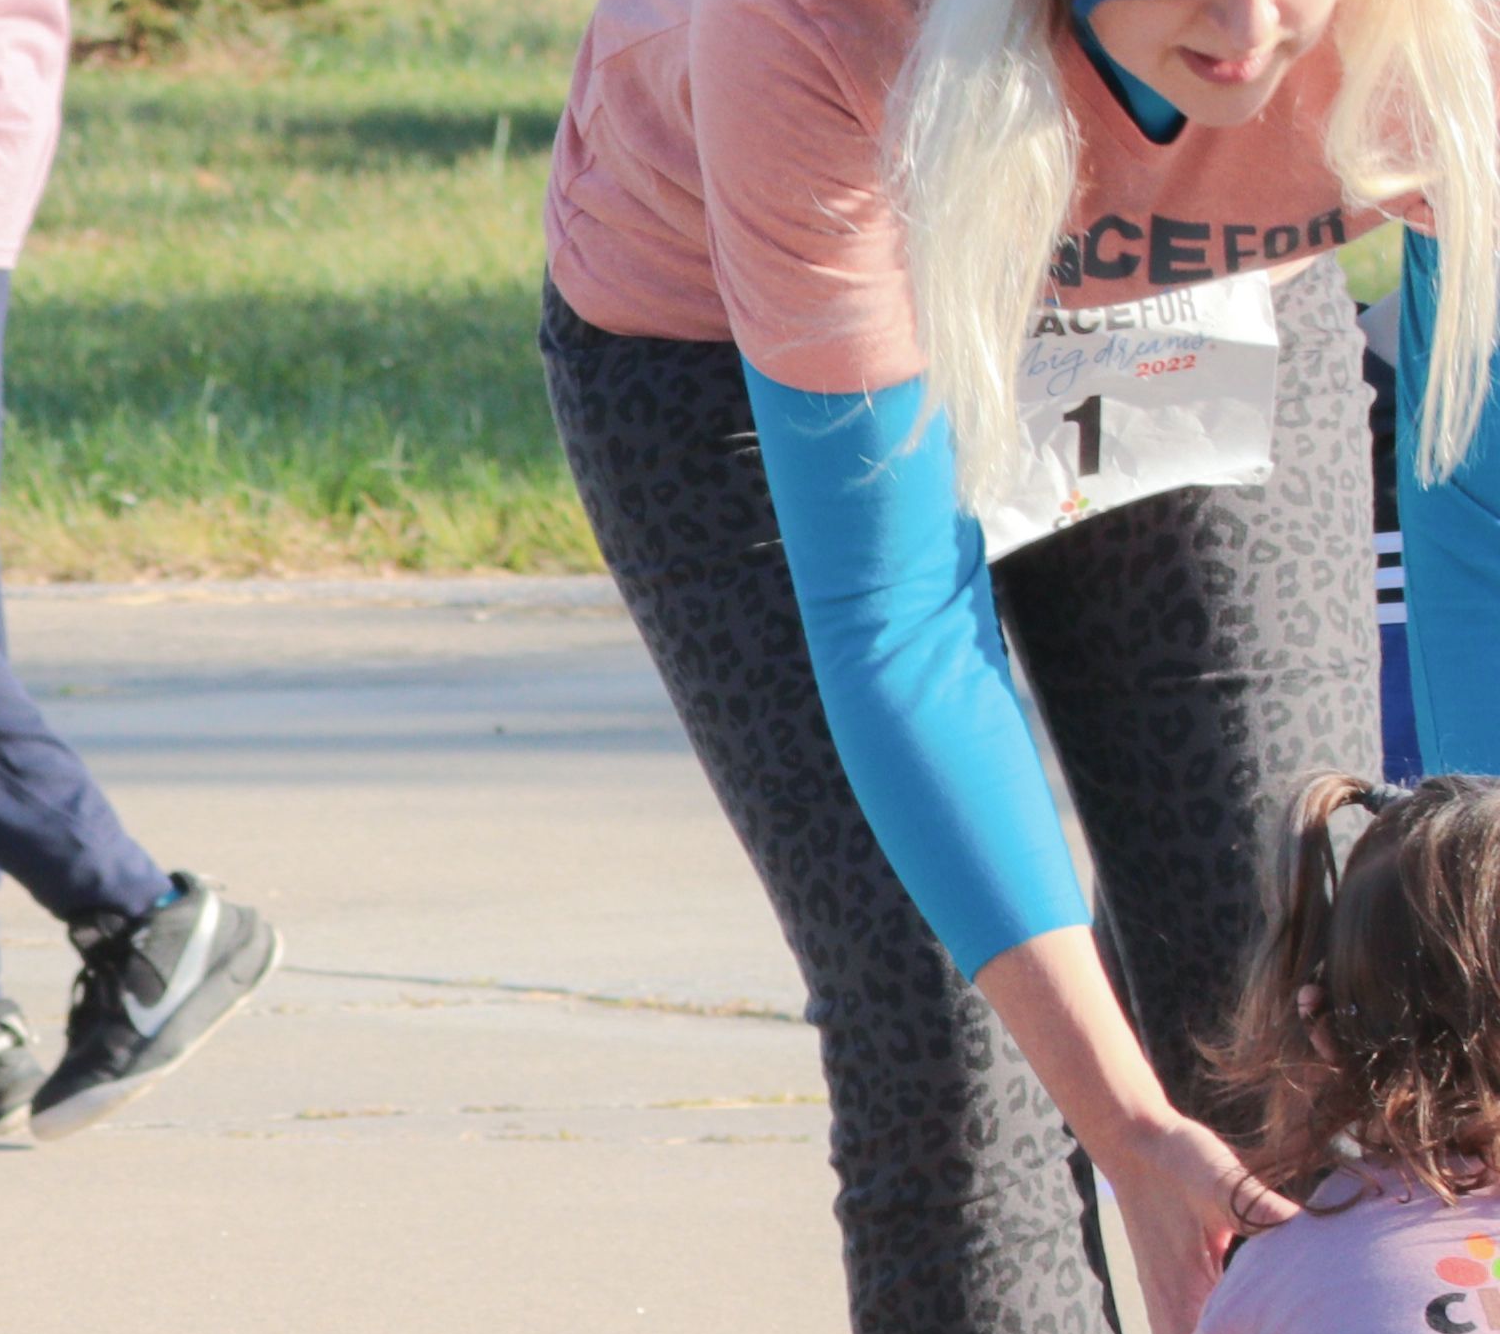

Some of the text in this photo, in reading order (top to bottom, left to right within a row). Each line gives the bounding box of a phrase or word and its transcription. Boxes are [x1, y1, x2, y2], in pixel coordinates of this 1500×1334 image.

[1049, 207, 1347, 288] ACE FOR
[1022, 342, 1087, 397] big
[1135, 353, 1196, 378] 2022
[1063, 395, 1101, 478] 1
